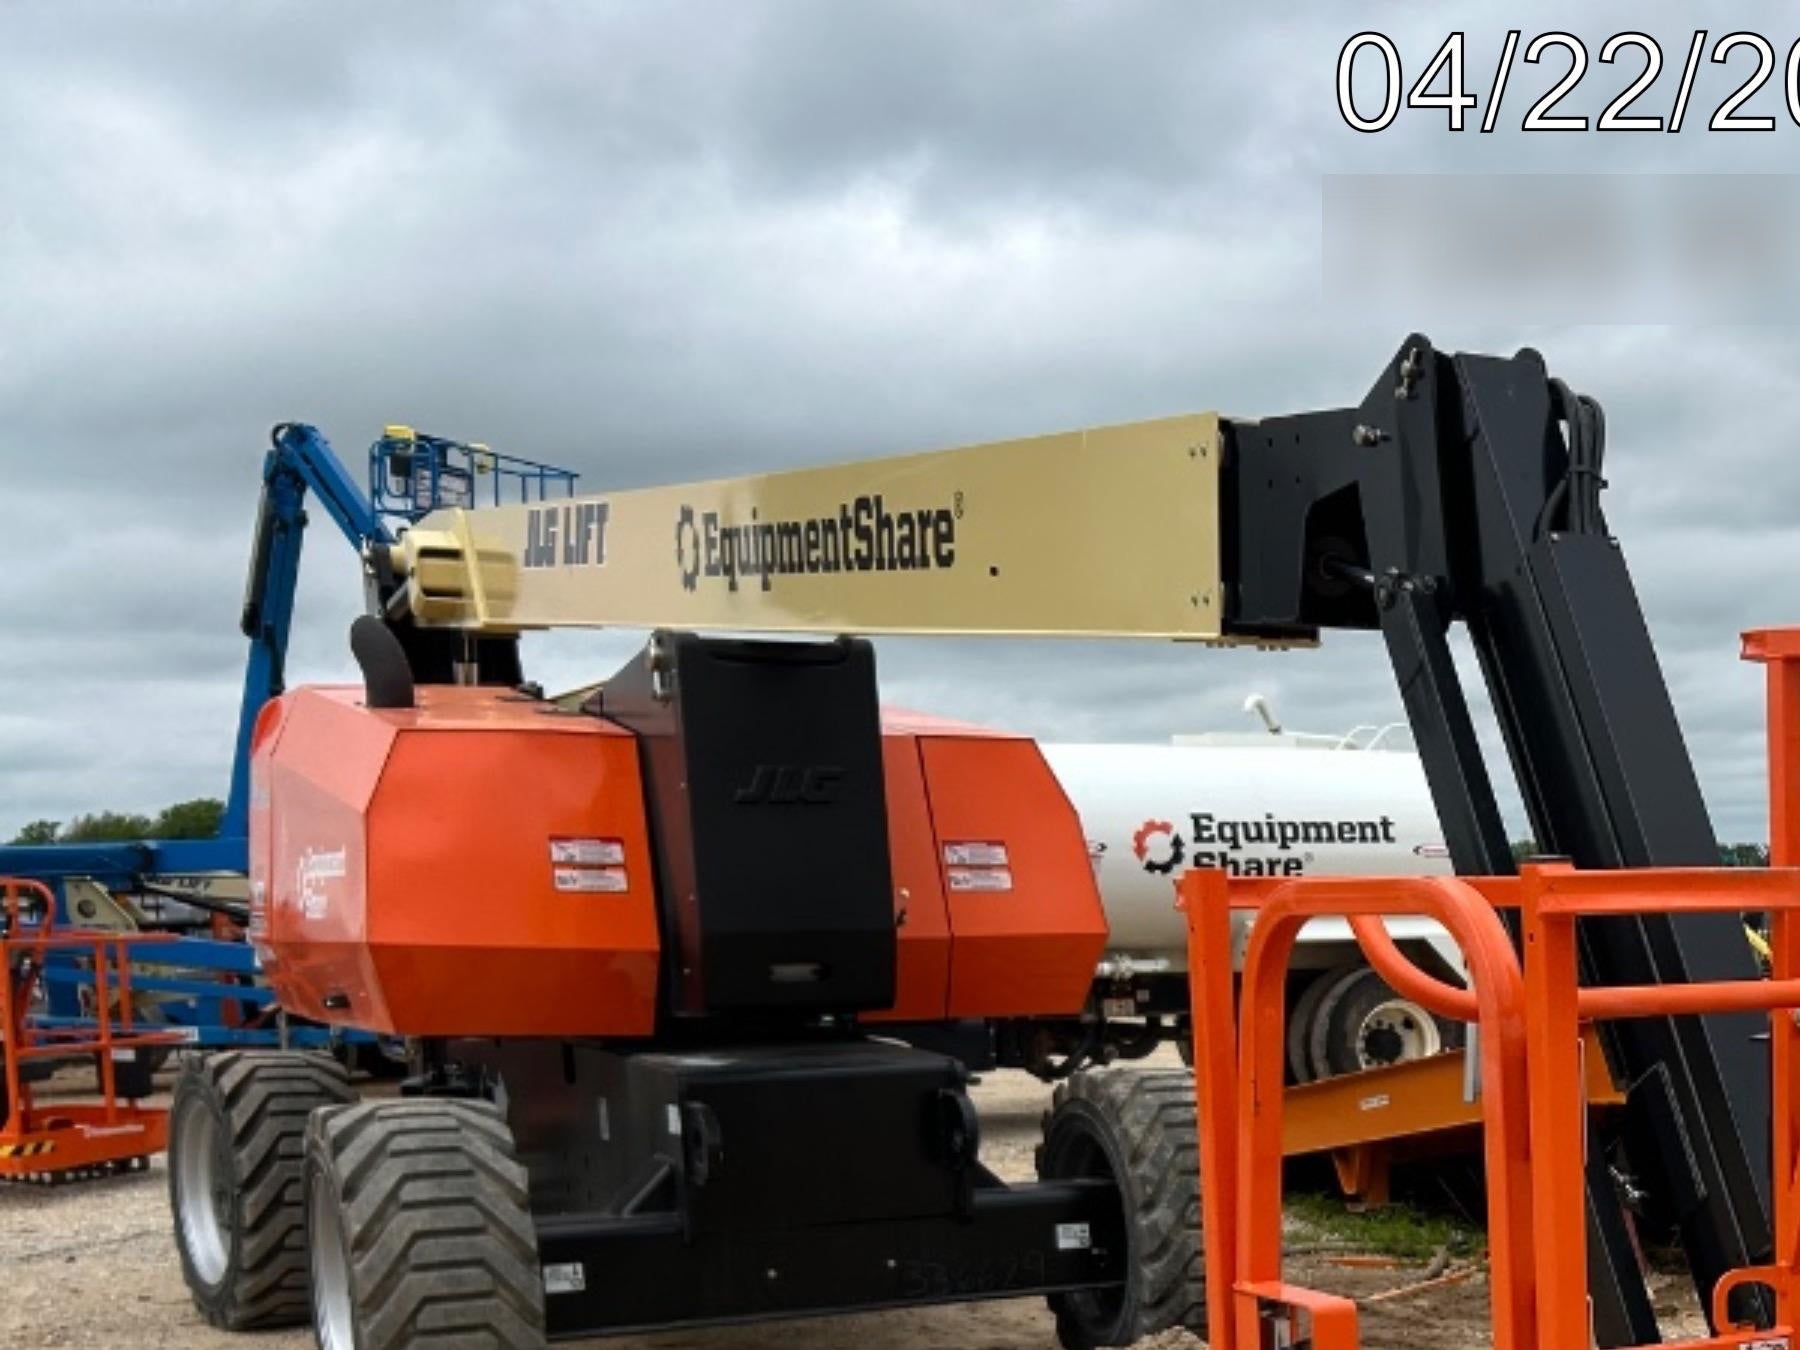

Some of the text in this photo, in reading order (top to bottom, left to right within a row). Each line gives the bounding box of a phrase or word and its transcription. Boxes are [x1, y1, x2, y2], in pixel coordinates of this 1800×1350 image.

[524, 502, 609, 569] JLG LIFT
[733, 764, 848, 805] JLG
[1190, 812, 1396, 850] Equipment
